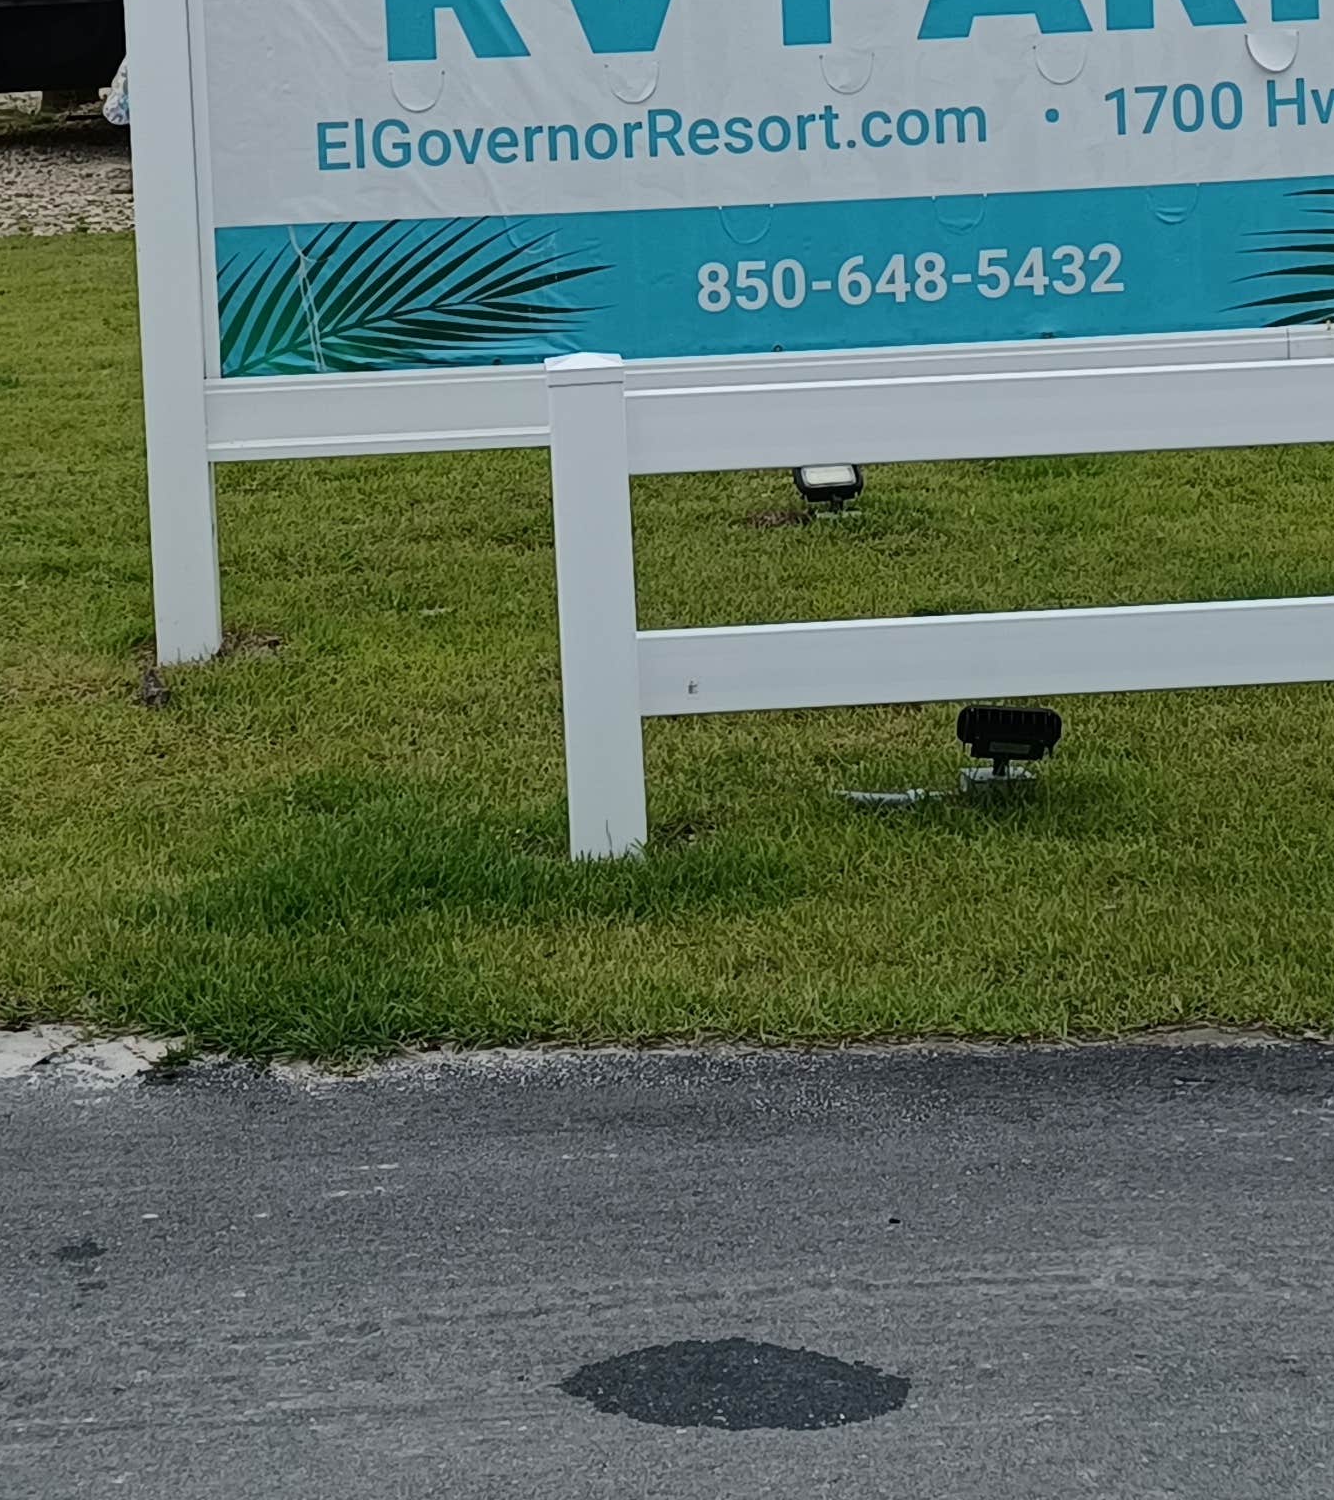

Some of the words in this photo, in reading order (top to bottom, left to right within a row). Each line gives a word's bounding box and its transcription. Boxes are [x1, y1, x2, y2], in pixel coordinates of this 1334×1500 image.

[316, 106, 987, 172] ElGovernorResort.com
[1104, 82, 1244, 136] 1700
[698, 245, 1124, 312] 850-648-5432
